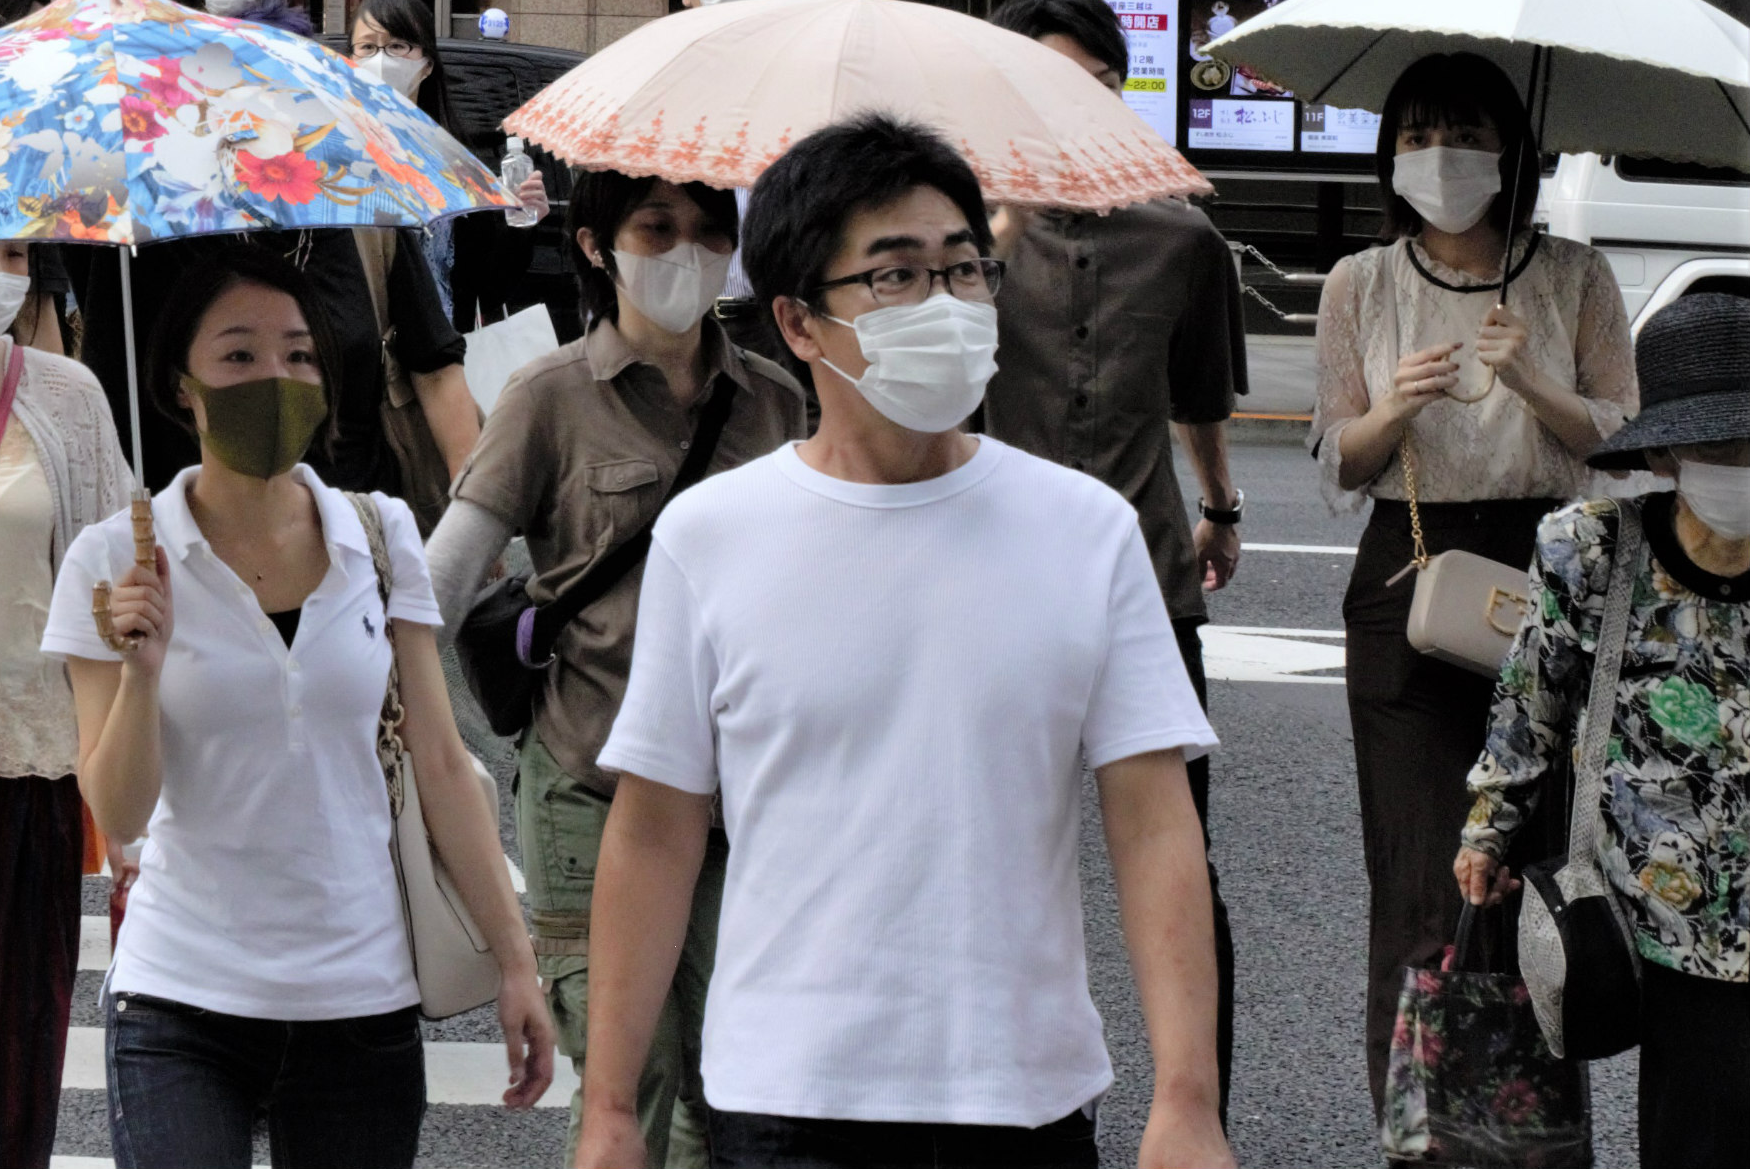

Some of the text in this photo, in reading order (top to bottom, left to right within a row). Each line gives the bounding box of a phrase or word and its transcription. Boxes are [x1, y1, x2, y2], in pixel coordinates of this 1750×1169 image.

[1127, 67, 1165, 76] 営業時間
[1192, 108, 1211, 119] 12F
[1305, 112, 1324, 122] 11F
